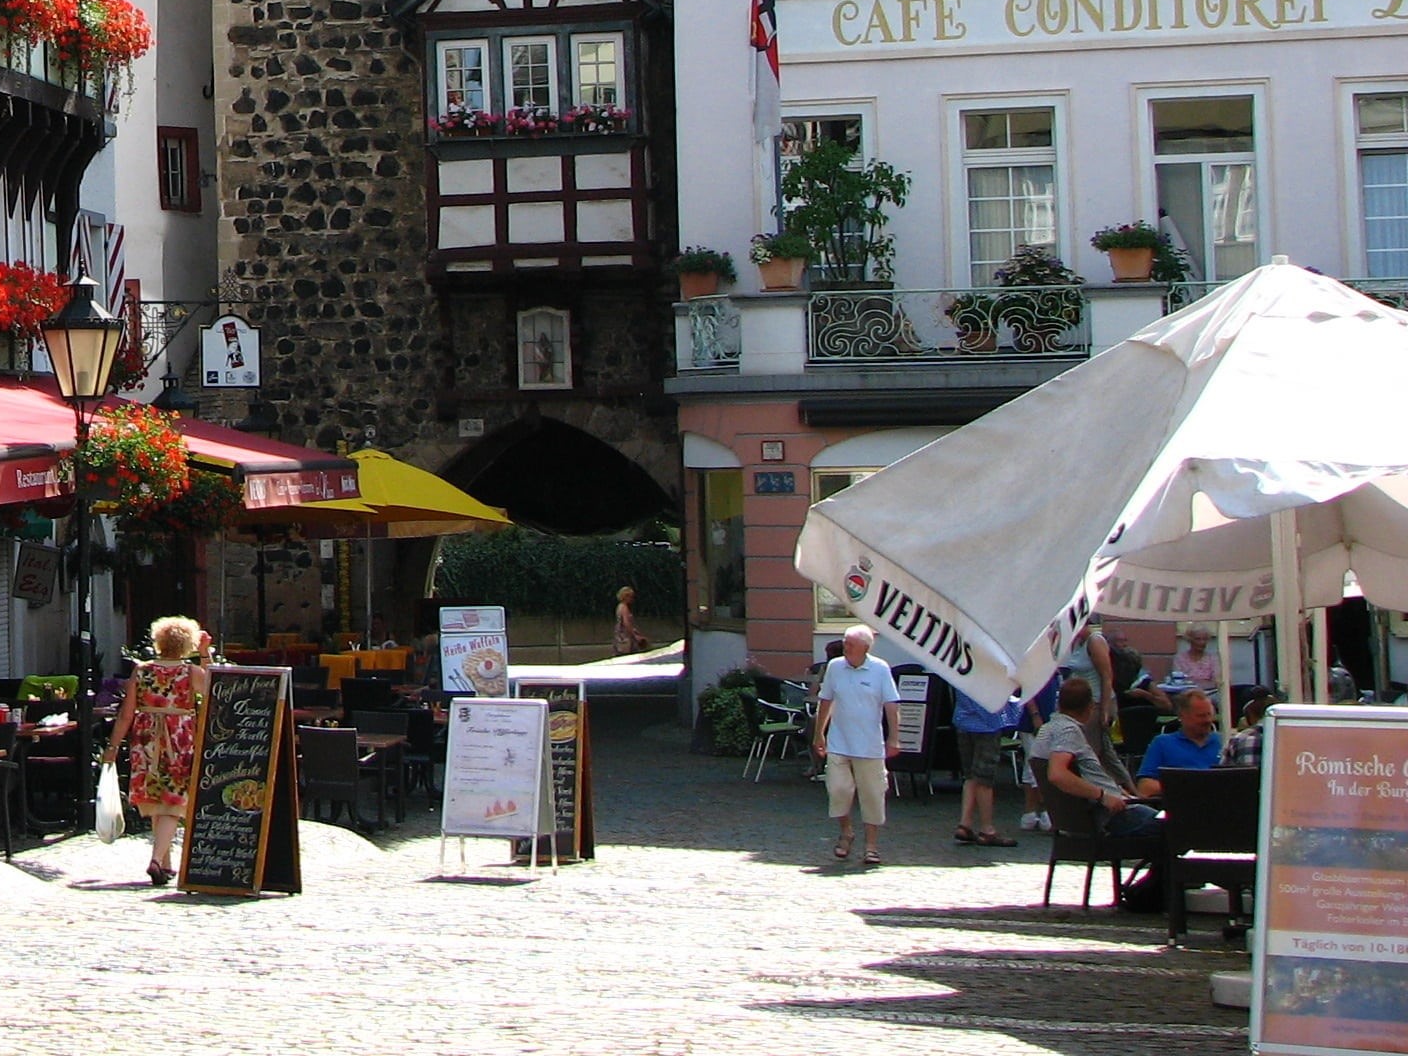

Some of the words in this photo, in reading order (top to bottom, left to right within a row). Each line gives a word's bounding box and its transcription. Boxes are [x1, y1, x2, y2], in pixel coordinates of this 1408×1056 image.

[873, 579, 974, 676] VELTINS
[1296, 751, 1396, 777] Römische
[1327, 779, 1345, 796] In
[1348, 781, 1372, 797] der
[1292, 937, 1338, 952] Täglich
[1342, 943, 1365, 952] von
